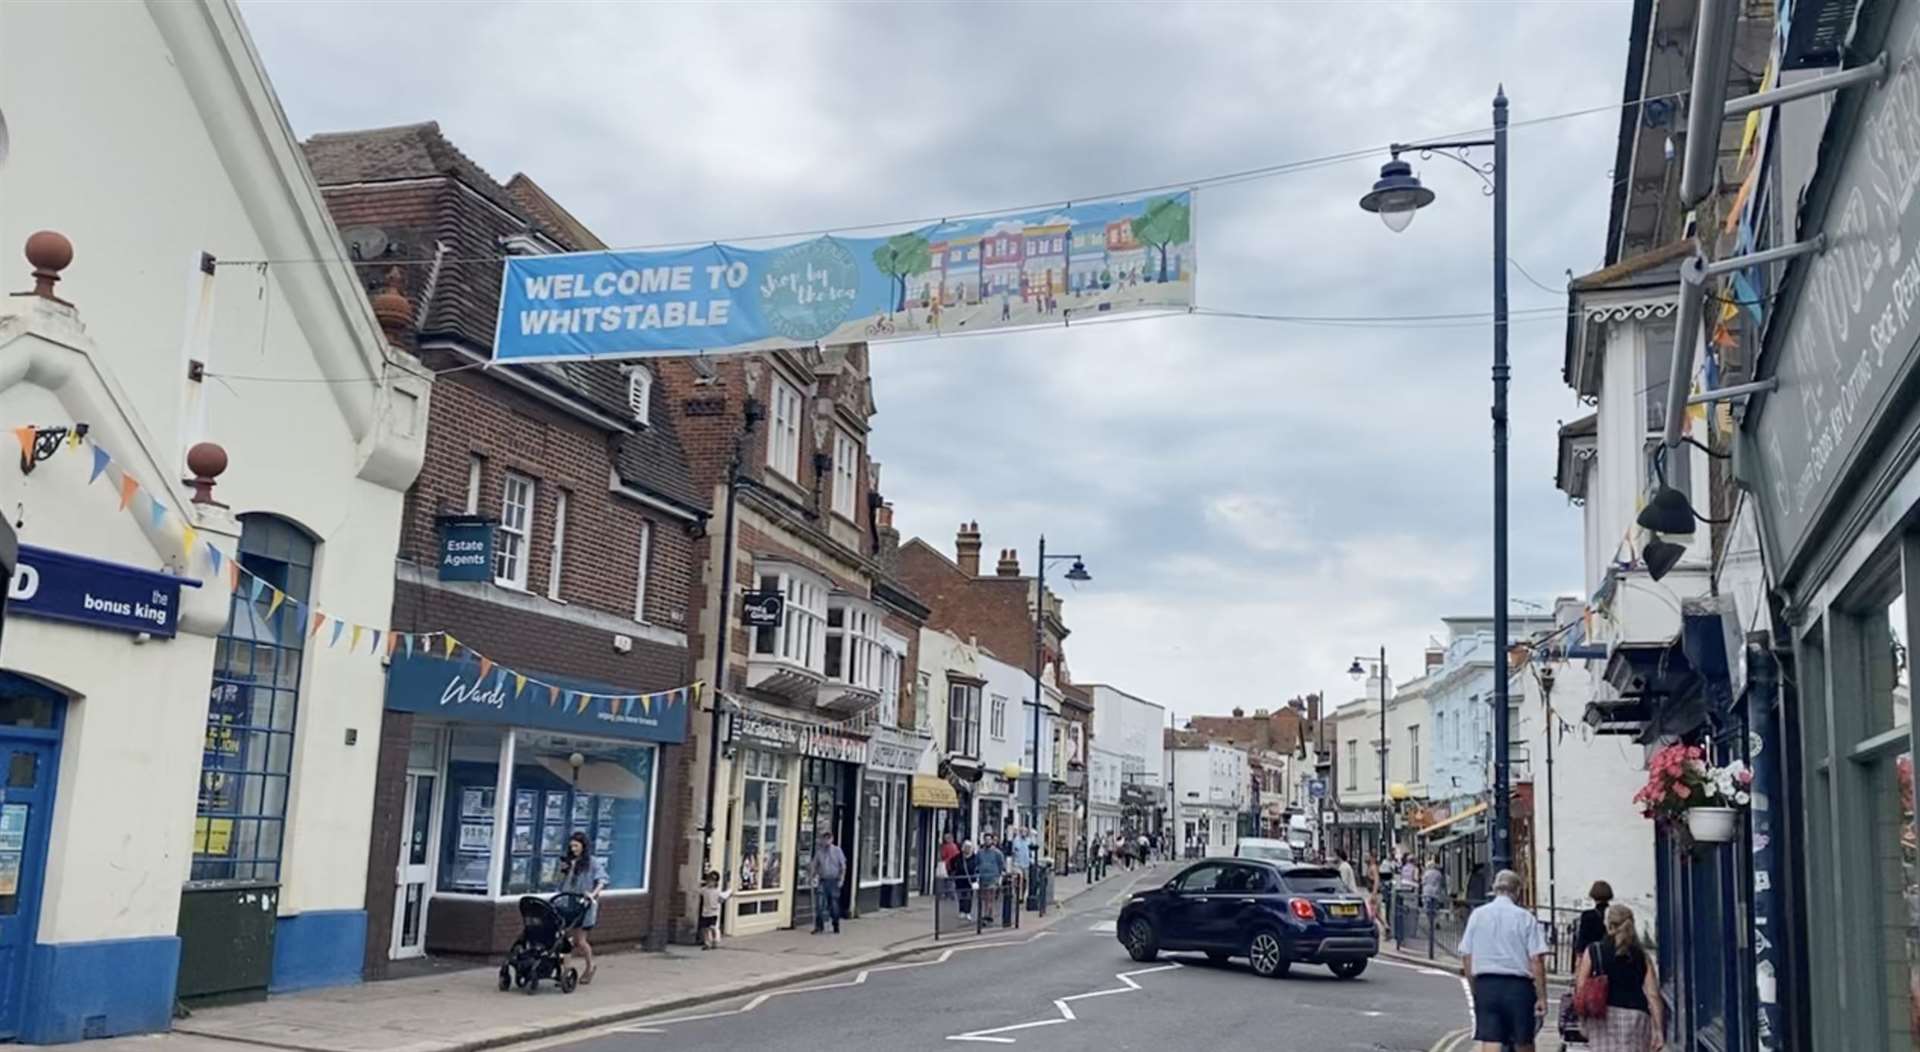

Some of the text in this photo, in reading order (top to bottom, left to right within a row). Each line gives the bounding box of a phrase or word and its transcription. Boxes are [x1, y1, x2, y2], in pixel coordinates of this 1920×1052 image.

[525, 261, 749, 300] WELCOME TO
[1810, 186, 1882, 386] YOUR
[520, 300, 731, 336] WHITSTABLE
[444, 554, 485, 567] Agents
[447, 540, 484, 552] Estate
[84, 593, 166, 624] bonus king
[152, 590, 168, 606] the
[440, 675, 506, 709] Wards
